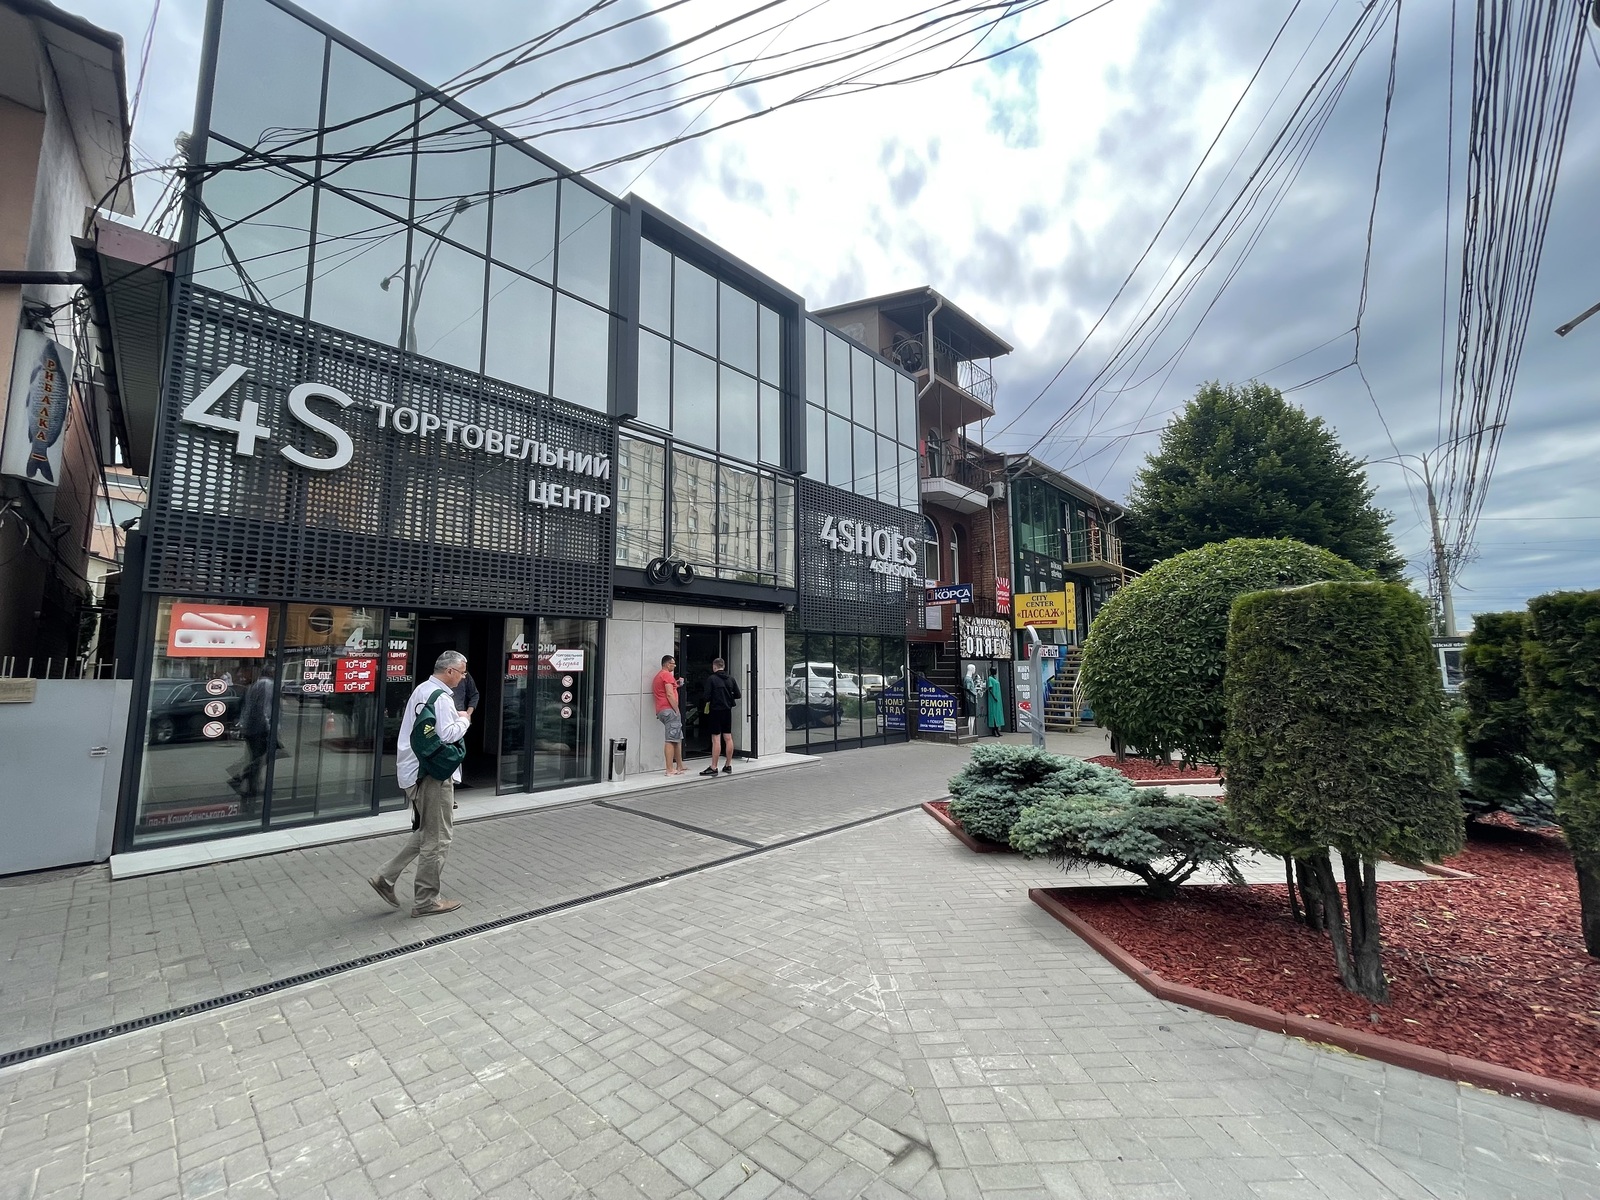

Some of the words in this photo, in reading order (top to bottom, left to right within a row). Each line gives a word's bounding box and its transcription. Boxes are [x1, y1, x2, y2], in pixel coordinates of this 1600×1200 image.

[371, 400, 611, 480] ТОРГОВЕЛЬНИЙ
[528, 479, 611, 514] ЦЕНТР
[820, 515, 917, 566] 4SHOES
[869, 560, 918, 579] 4SEASONS
[935, 588, 971, 600] КОРСА
[1026, 600, 1054, 608] CENTER
[1017, 608, 1064, 618] «ПАССАЖ»
[966, 625, 1007, 638] ТУРЕЦЬКОГО
[966, 636, 1006, 657] ОДЯГУ
[304, 659, 319, 667] ПН
[920, 699, 954, 708] РЕМОНТ
[920, 707, 954, 717] ОДЯГУ
[227, 804, 239, 817] 25
